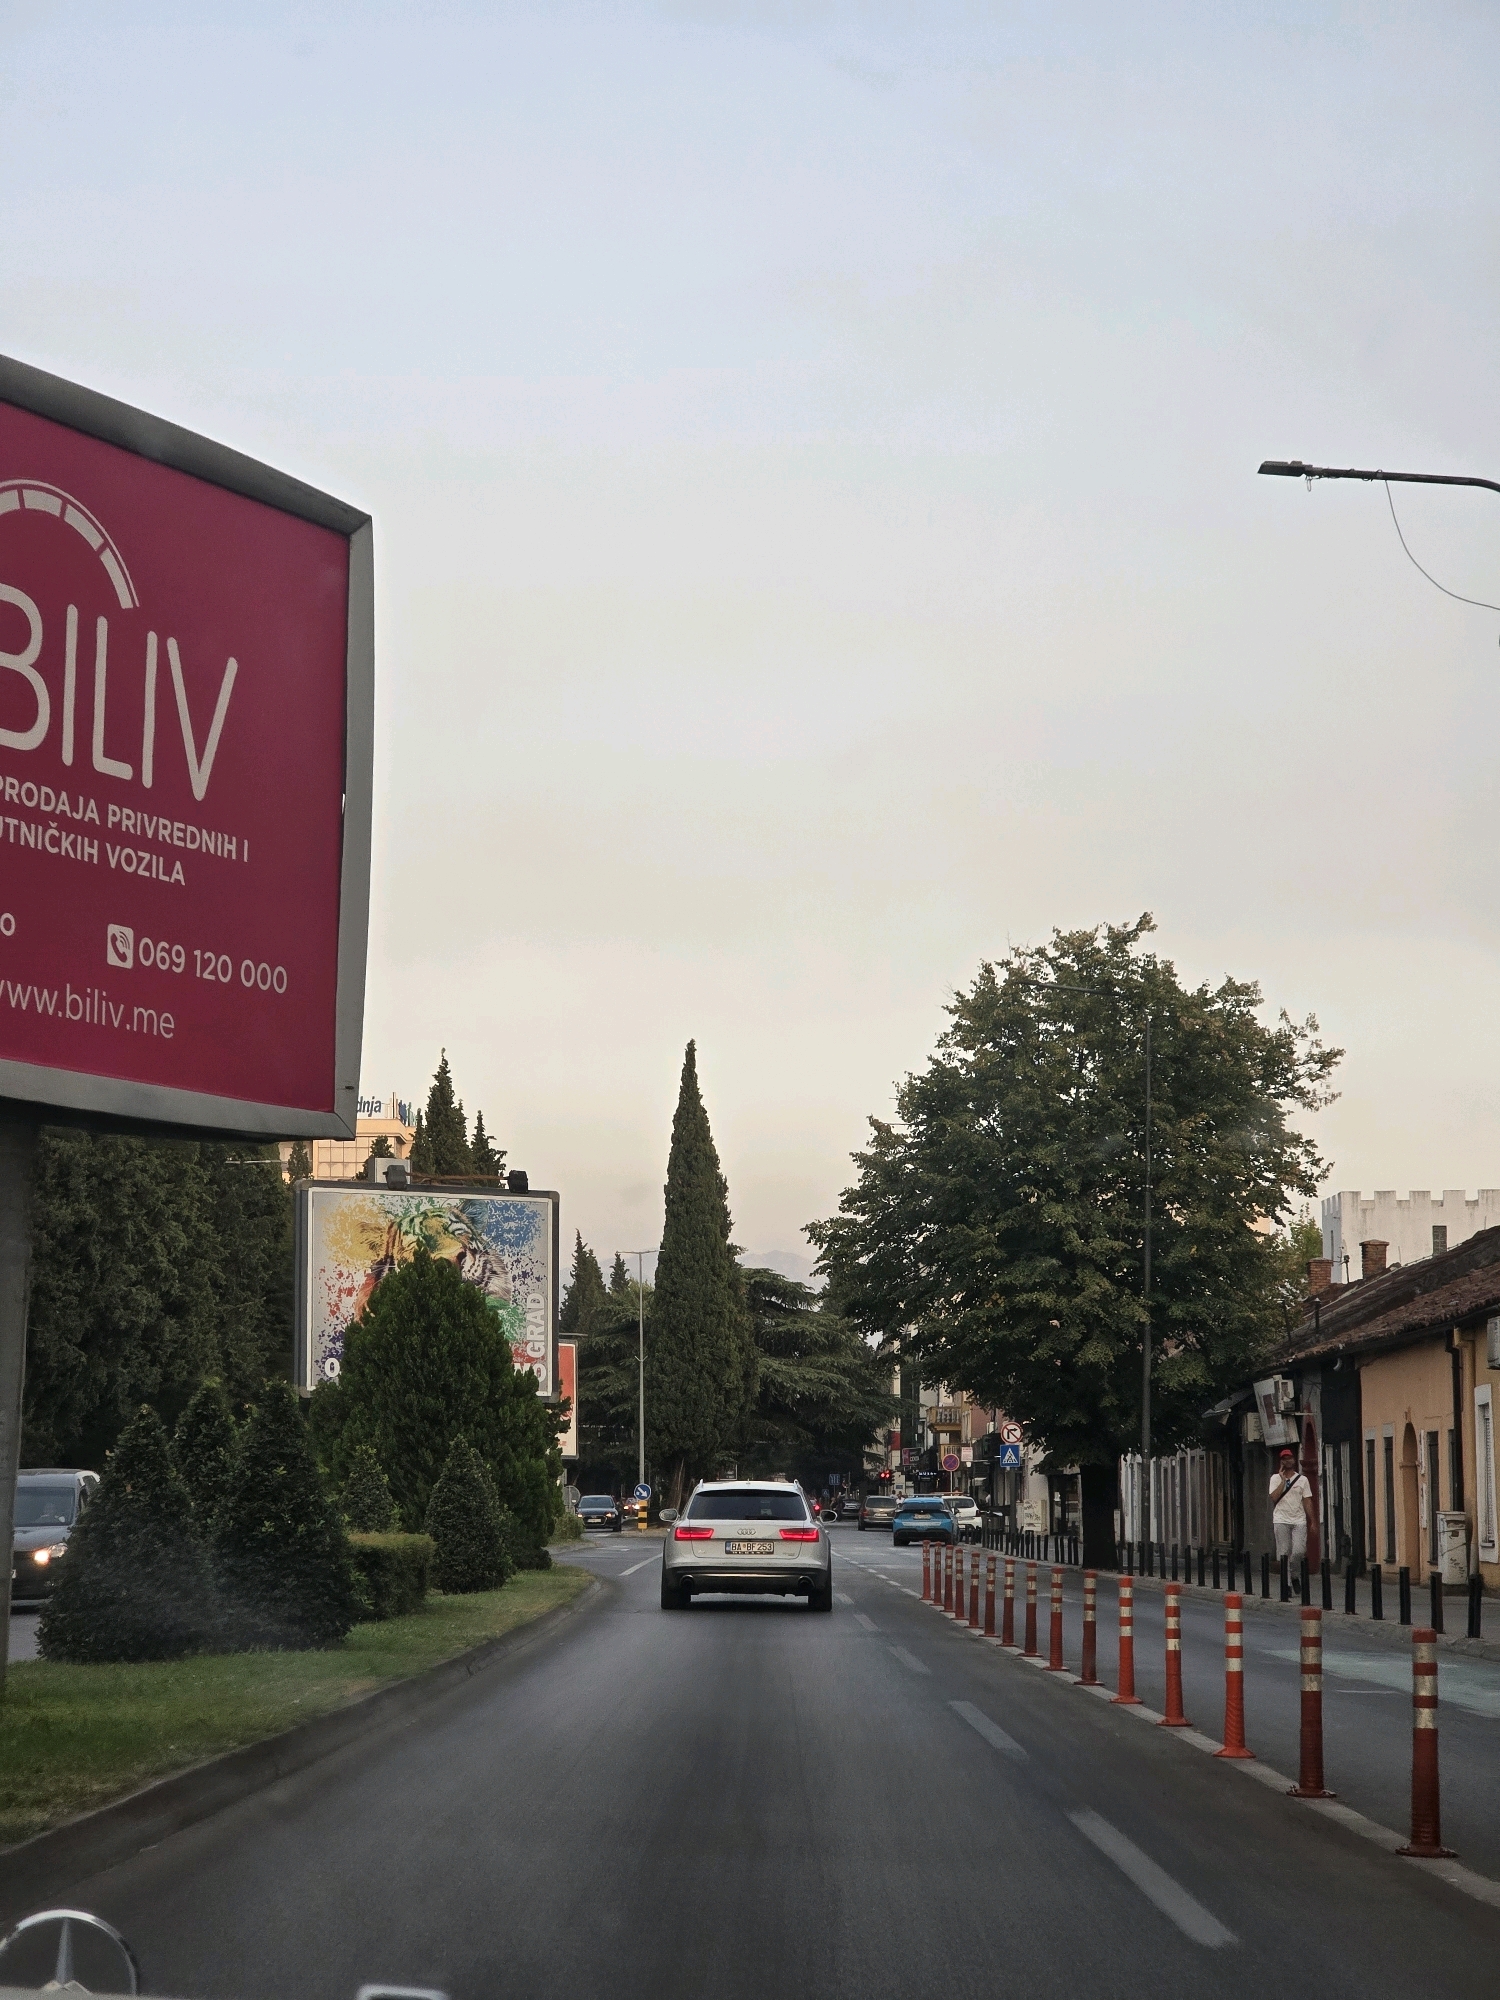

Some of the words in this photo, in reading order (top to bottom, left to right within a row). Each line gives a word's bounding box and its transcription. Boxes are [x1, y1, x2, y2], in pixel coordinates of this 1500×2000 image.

[0, 582, 238, 801] BILIV
[107, 803, 237, 860] PRIVREDNIH
[243, 839, 249, 862] I
[105, 842, 186, 886] VOZILA
[138, 936, 186, 973] 069
[193, 949, 233, 983] 120
[240, 959, 288, 994] 000
[0, 980, 175, 1039] ww.biliv.me
[526, 1293, 546, 1358] GRAD
[731, 1542, 742, 1551] BA
